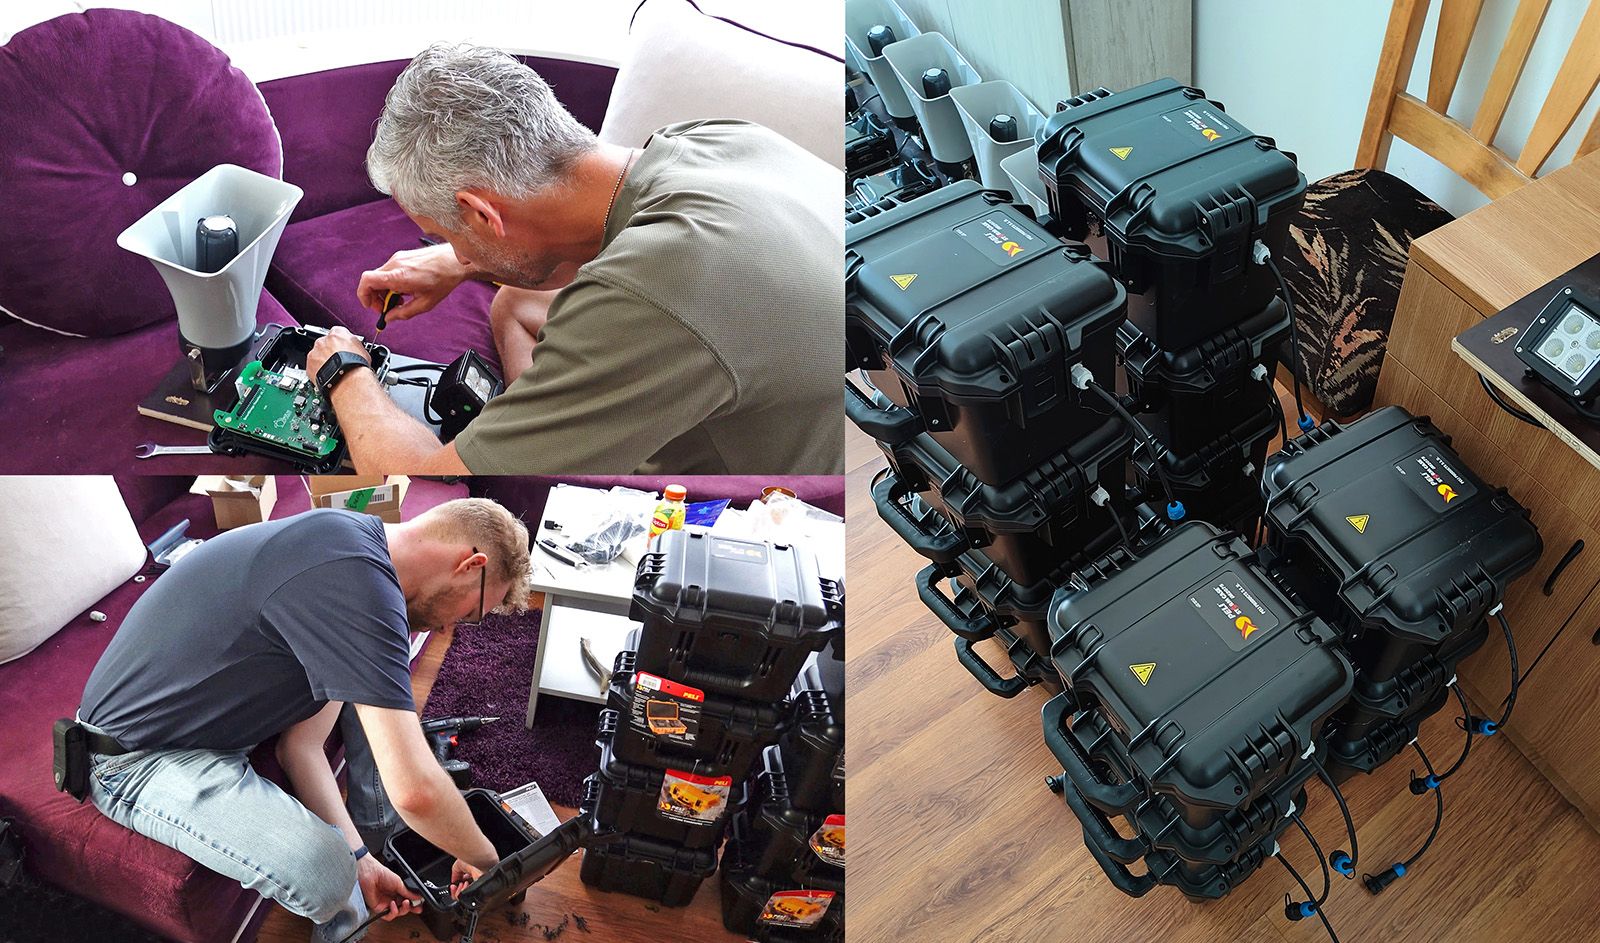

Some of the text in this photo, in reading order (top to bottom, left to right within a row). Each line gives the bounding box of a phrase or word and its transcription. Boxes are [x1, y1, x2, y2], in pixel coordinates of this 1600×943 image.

[984, 232, 1002, 244] PELI
[1421, 472, 1437, 486] PELI
[1215, 587, 1242, 615] STORM CASE
[1218, 602, 1236, 619] PELI
[683, 692, 699, 700] PELI
